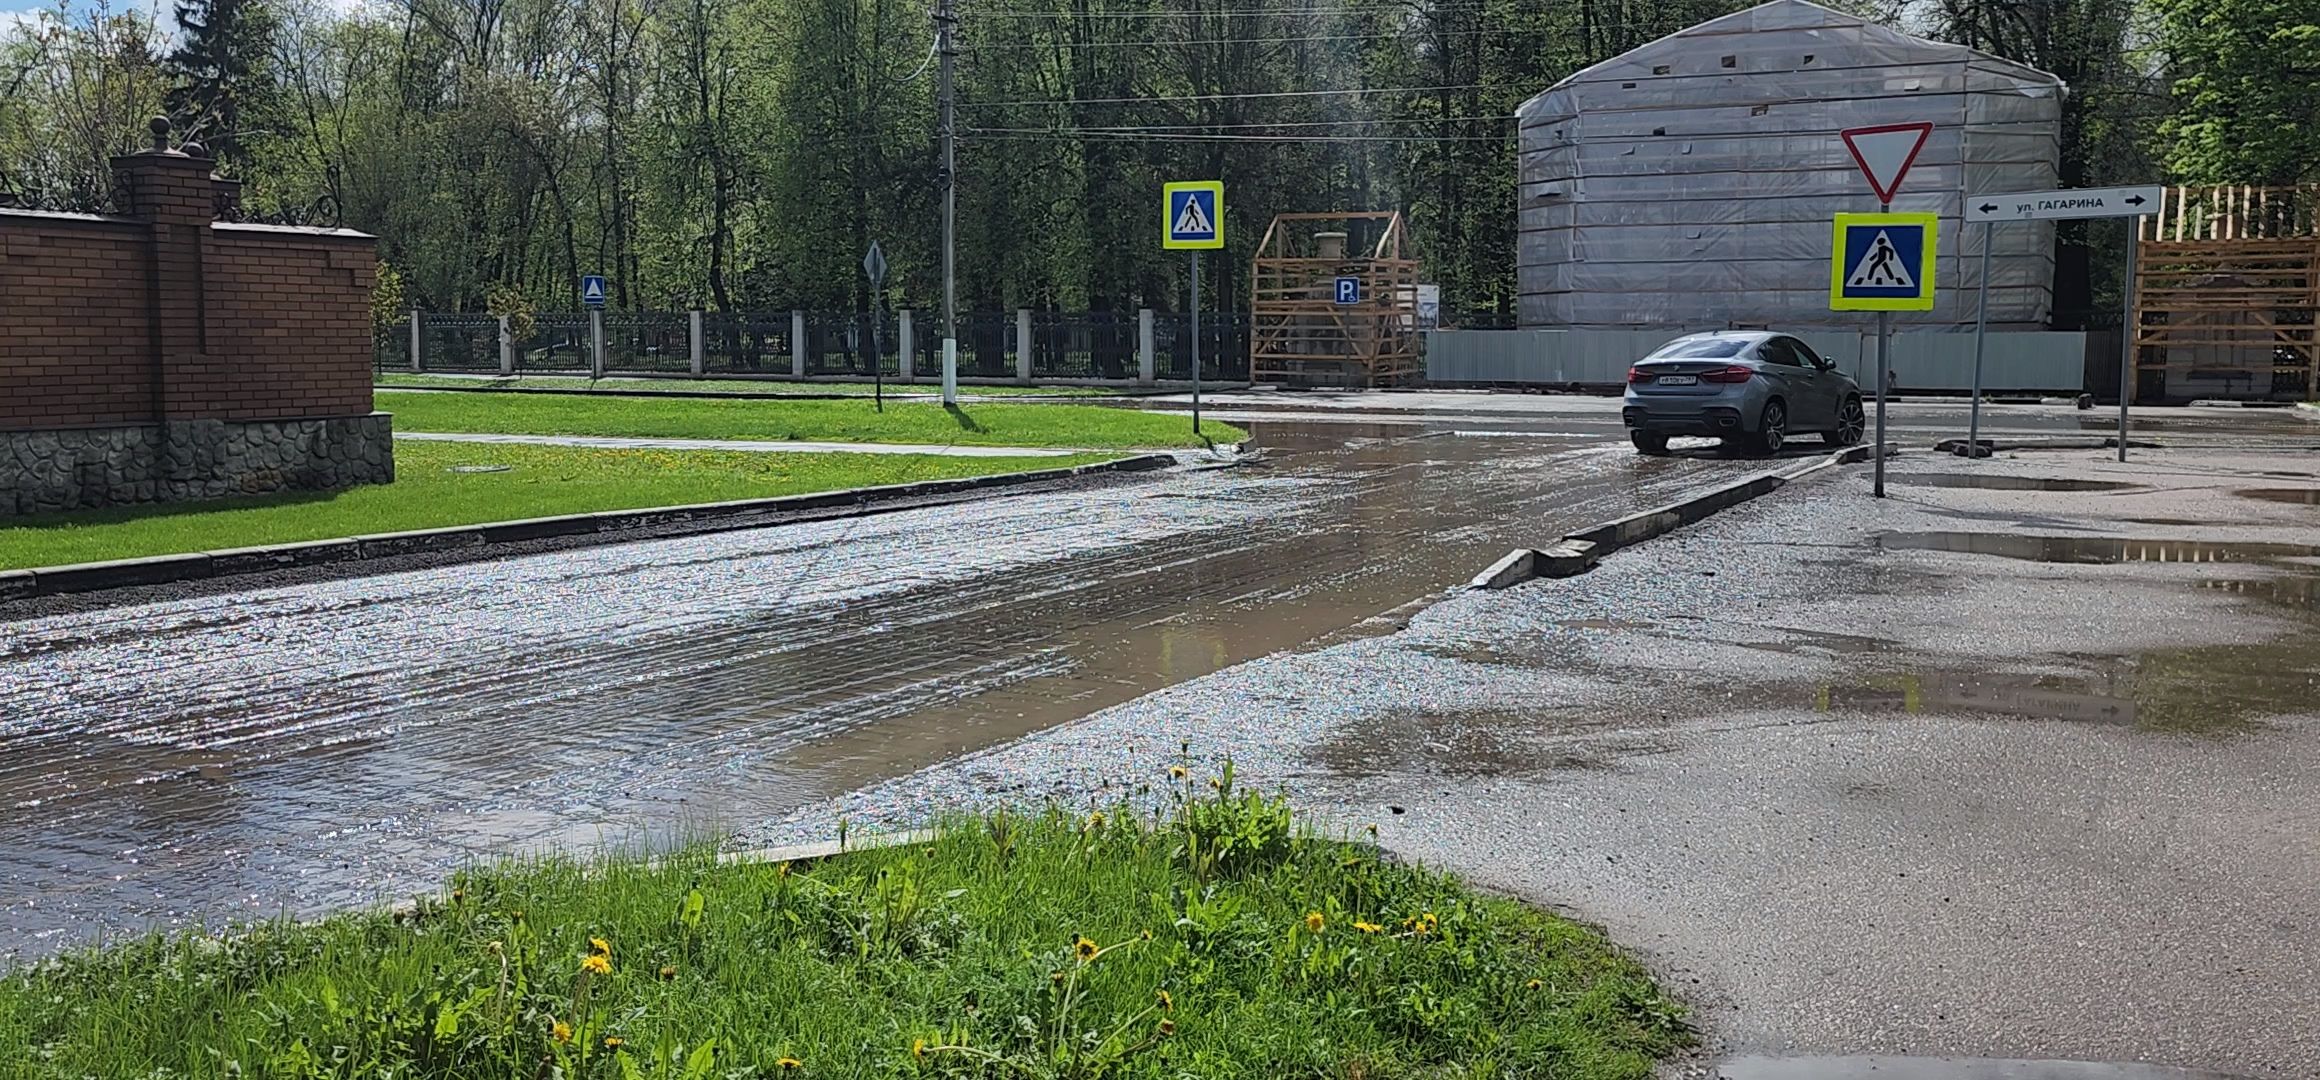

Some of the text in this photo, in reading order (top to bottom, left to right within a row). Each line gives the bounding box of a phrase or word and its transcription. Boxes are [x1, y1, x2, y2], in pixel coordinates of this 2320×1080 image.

[2016, 198, 2104, 213] ул. ГАГАРИНА
[1340, 281, 1354, 301] P
